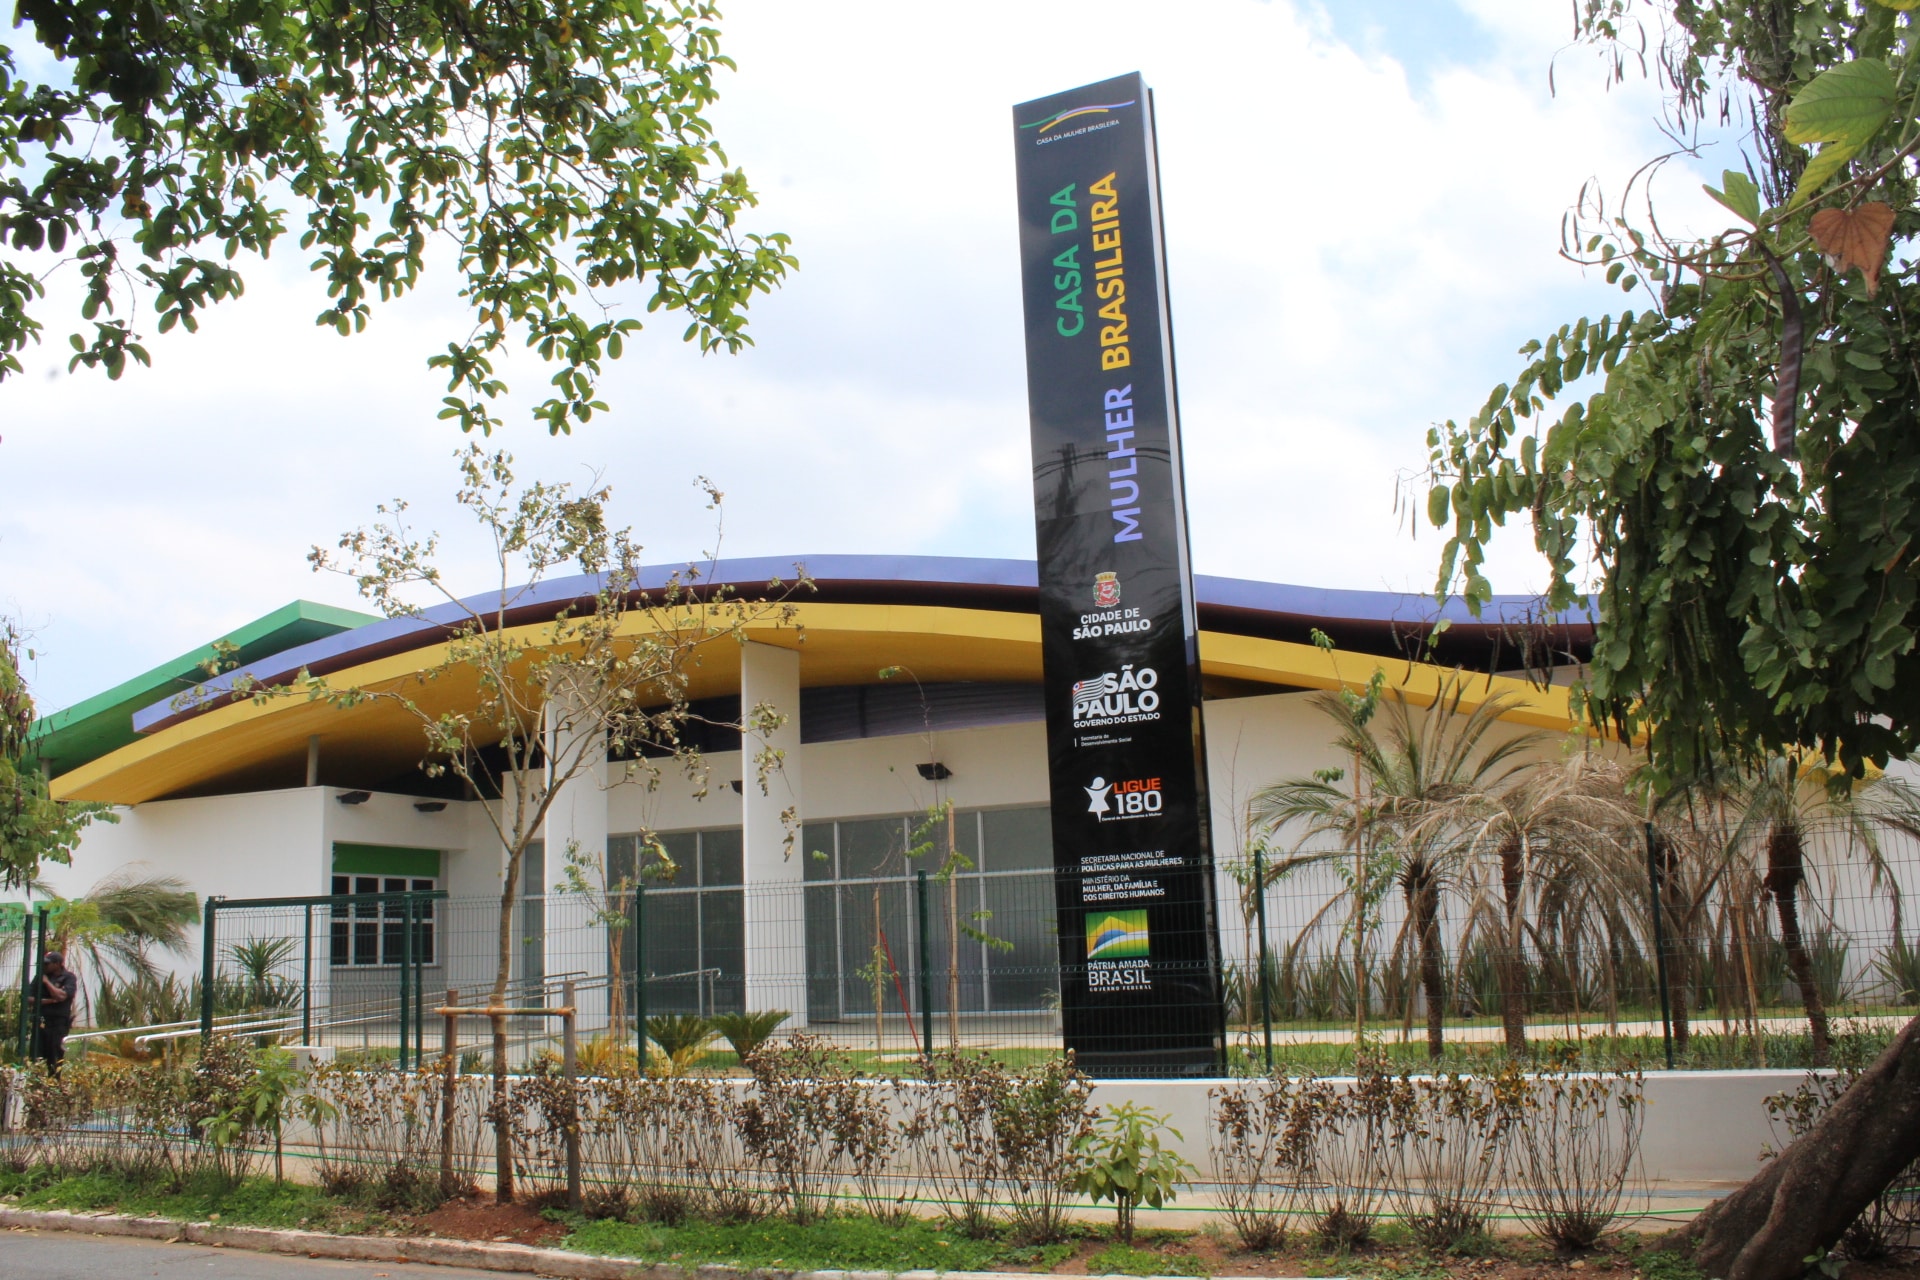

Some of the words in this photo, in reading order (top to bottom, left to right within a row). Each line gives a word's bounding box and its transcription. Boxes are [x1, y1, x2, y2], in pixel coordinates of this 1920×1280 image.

[1036, 137, 1053, 145] CASA
[1063, 127, 1086, 138] MULHER
[1088, 119, 1120, 132] BRASILEIRA
[1050, 183, 1078, 234] DA
[1089, 171, 1131, 371] BRASILEIRA
[1053, 244, 1085, 337] CASA
[1104, 383, 1143, 544] MULHER
[1080, 610, 1122, 625] CIDADE
[1124, 607, 1140, 619] DE
[1073, 624, 1102, 640] SÃO
[1104, 618, 1151, 636] PAULO
[1103, 664, 1158, 694] SÃO
[1073, 690, 1160, 720] PAULO
[1073, 717, 1113, 728] GOVERNO
[1114, 716, 1127, 724] DO
[1128, 712, 1160, 722] ESTADO
[1113, 777, 1161, 794] LIGUE
[1115, 790, 1162, 815] 180
[1081, 854, 1120, 865] SECRETARIA
[1121, 851, 1154, 861] NACIONAL
[1155, 850, 1165, 858] DE
[1081, 862, 1115, 873] POLÍTICAS
[1116, 861, 1134, 870] PARA
[1135, 860, 1144, 868] AS
[1145, 857, 1182, 867] MULHERES
[1082, 874, 1119, 885] MINISTÉRIO
[1082, 884, 1113, 894] MULHER,
[1114, 882, 1124, 890] DA
[1125, 880, 1152, 890] FAMÍLIA
[1083, 893, 1097, 902] DOS
[1098, 890, 1128, 900] DIREITOS
[1129, 888, 1165, 898] HUMANOS
[1088, 960, 1116, 970] PÁTRIA
[1119, 959, 1150, 969] AMADA
[1089, 969, 1151, 986] BRASIL
